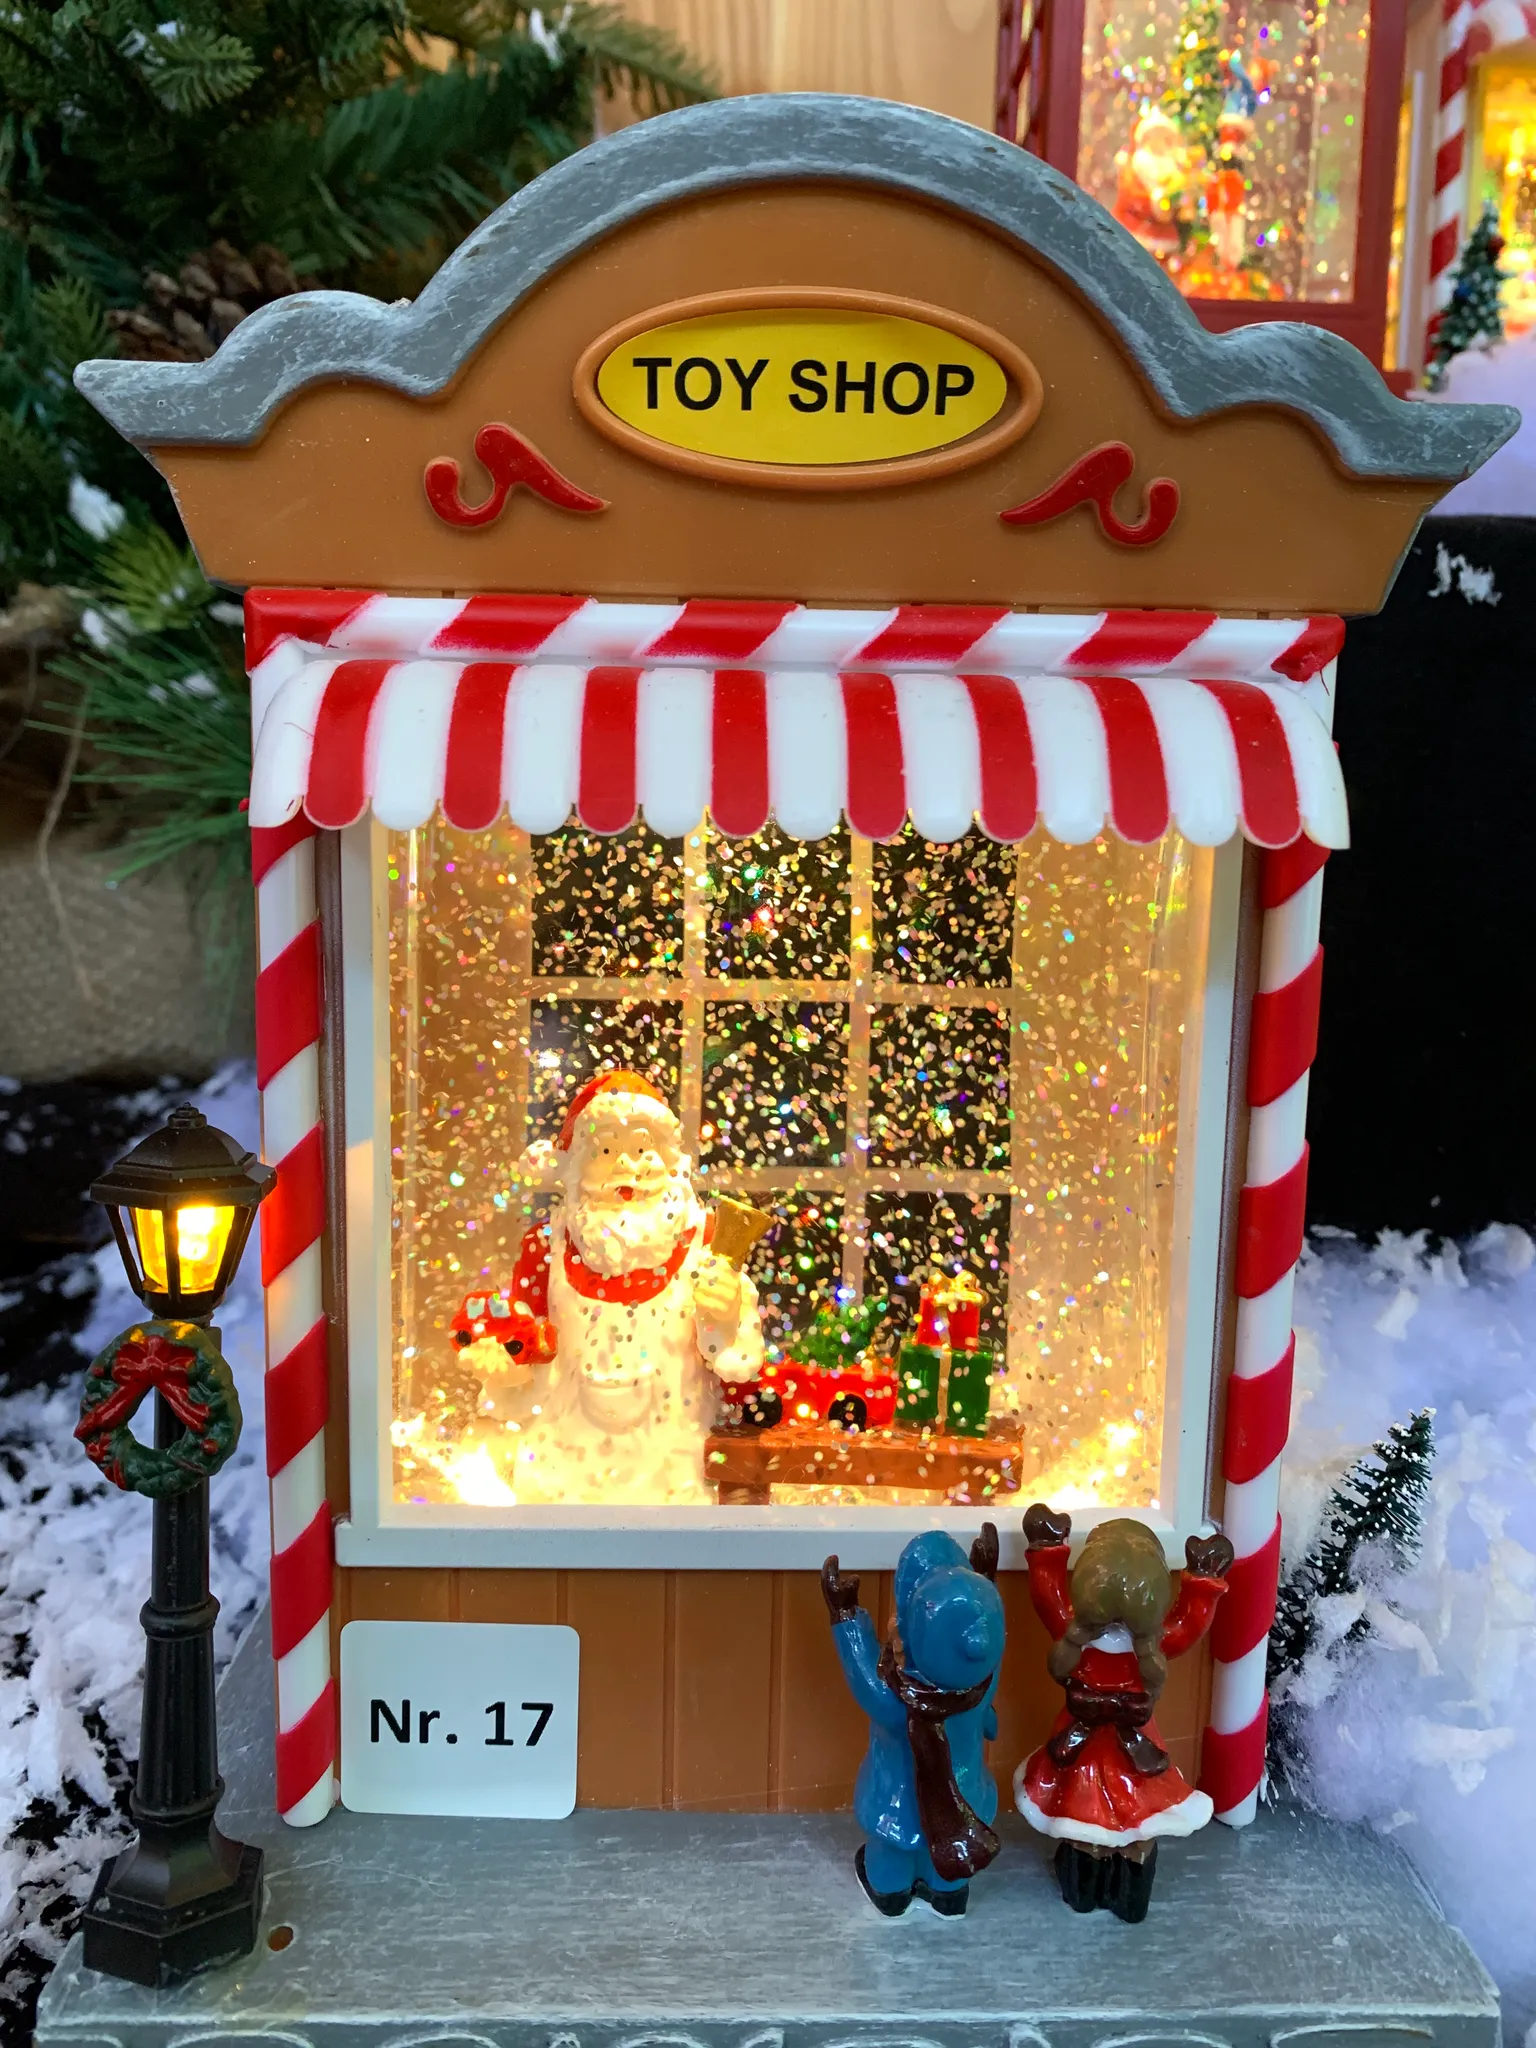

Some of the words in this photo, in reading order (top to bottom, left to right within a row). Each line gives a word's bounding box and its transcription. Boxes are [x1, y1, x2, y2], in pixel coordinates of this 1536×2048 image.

[632, 357, 770, 411] TOY
[788, 359, 975, 416] SHOP
[370, 1699, 458, 1745] Nr.
[484, 1701, 554, 1747] 17
